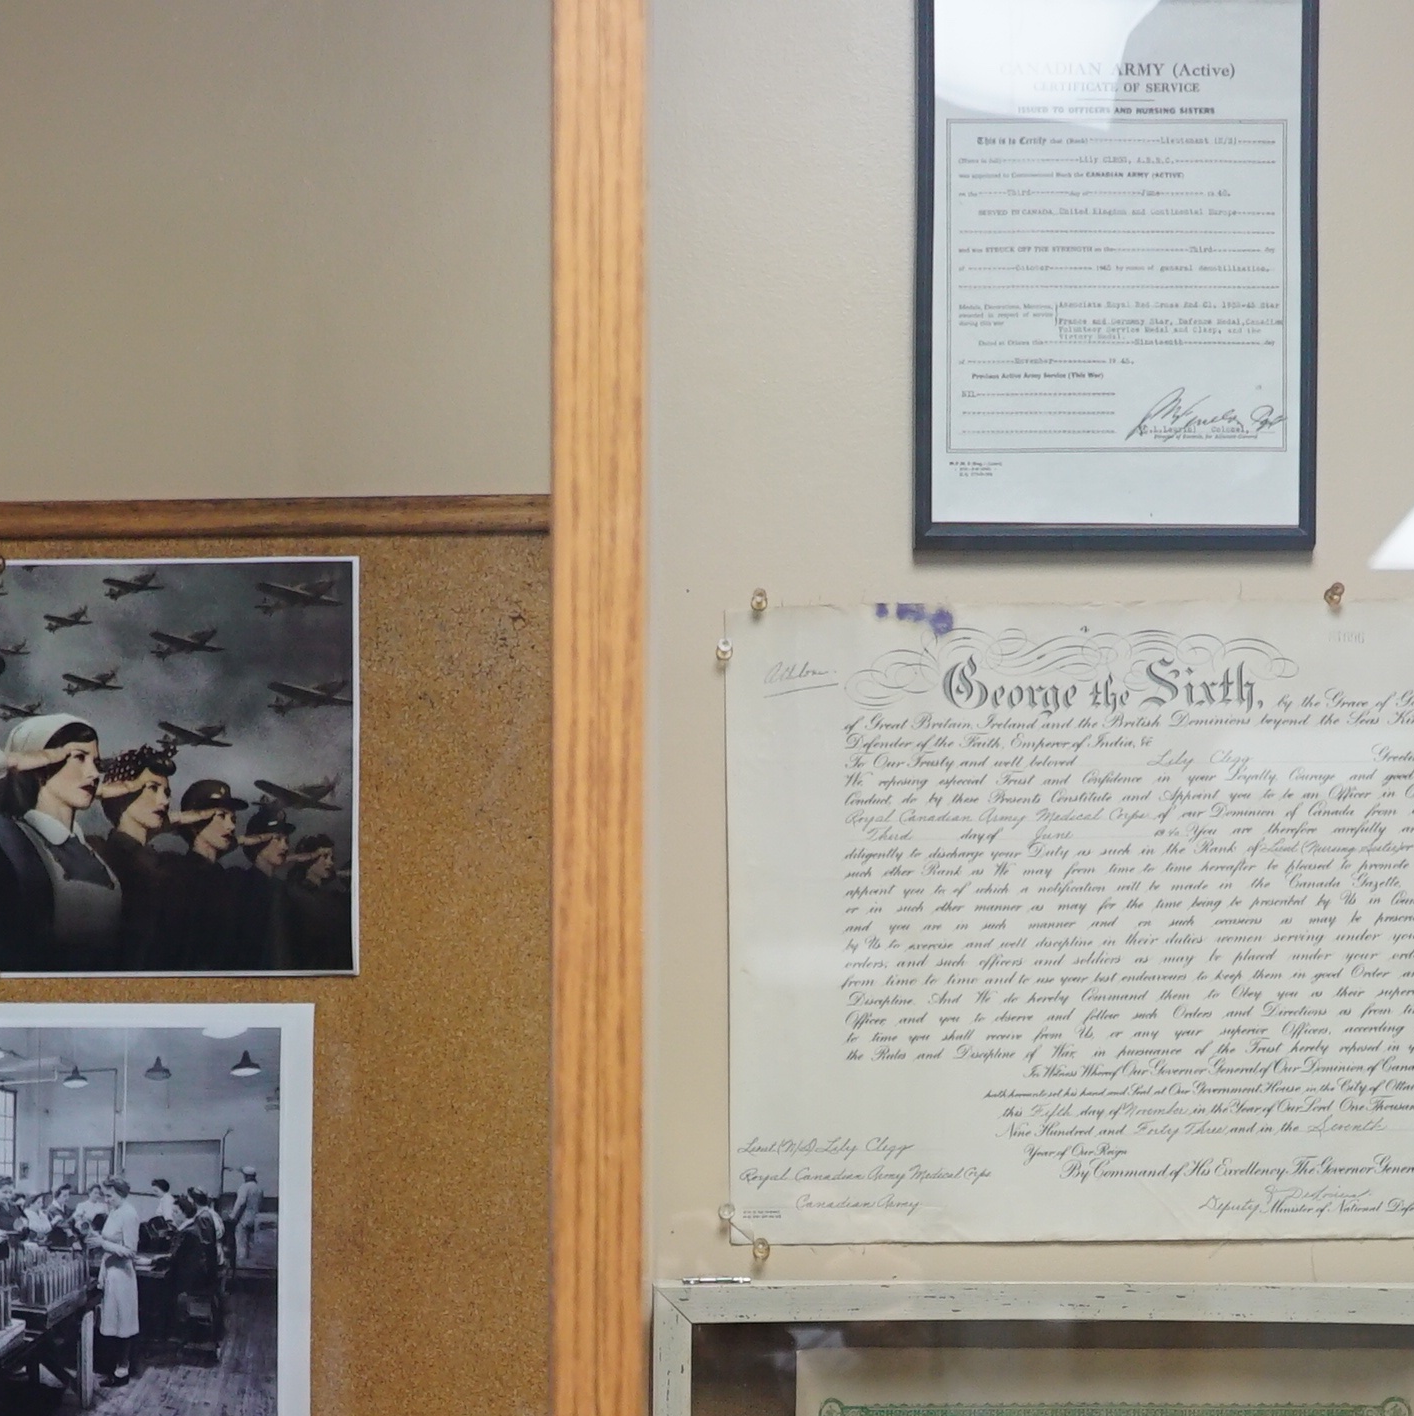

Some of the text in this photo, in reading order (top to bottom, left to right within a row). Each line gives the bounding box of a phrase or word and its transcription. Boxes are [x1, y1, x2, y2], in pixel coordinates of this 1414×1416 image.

[1111, 62, 1164, 76] ARMY
[1172, 62, 1236, 78] (Active)
[1033, 82, 1200, 93] CERTIFICATE OF SERVICE
[1114, 107, 1133, 115] AND
[1136, 107, 1176, 115] NURSING
[1179, 107, 1216, 115] SISTERS
[943, 654, 1078, 715] George
[1089, 671, 1131, 713] the
[1325, 687, 1369, 709] Grace
[865, 712, 909, 731] Great
[1040, 716, 1074, 730] and
[1075, 716, 1098, 730] the
[1101, 708, 1161, 730] British
[1168, 710, 1252, 728] Dominions
[1319, 713, 1341, 727] the
